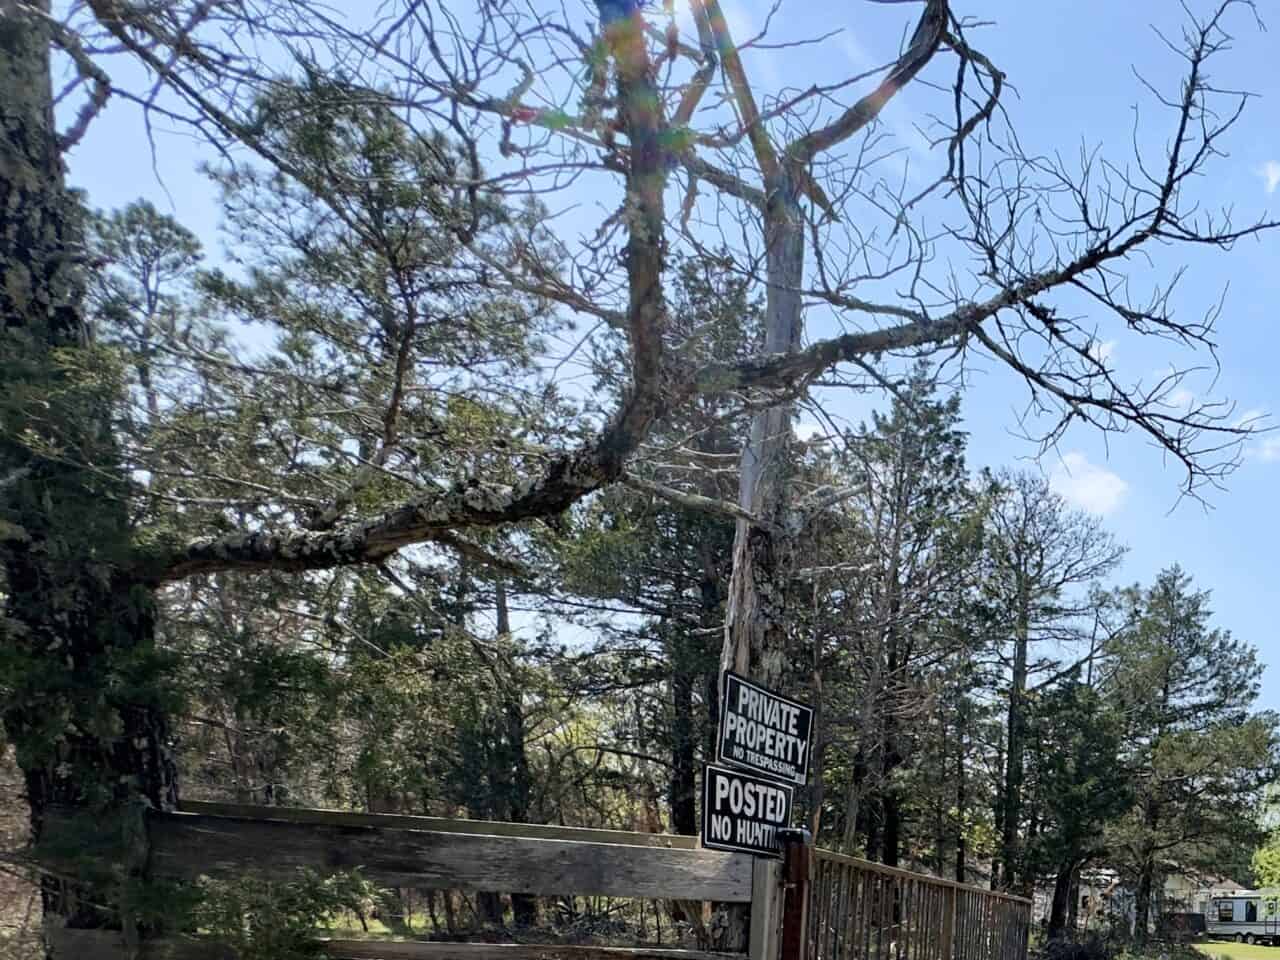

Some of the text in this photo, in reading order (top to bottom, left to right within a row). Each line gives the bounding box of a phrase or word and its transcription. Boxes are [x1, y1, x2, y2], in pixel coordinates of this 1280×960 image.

[738, 684, 800, 735] PRIVATE
[725, 711, 806, 765] PROPERTY
[732, 745, 796, 777] NO TRESPASSING
[715, 775, 786, 823] POSTED
[711, 813, 780, 849] NO HUNTI
